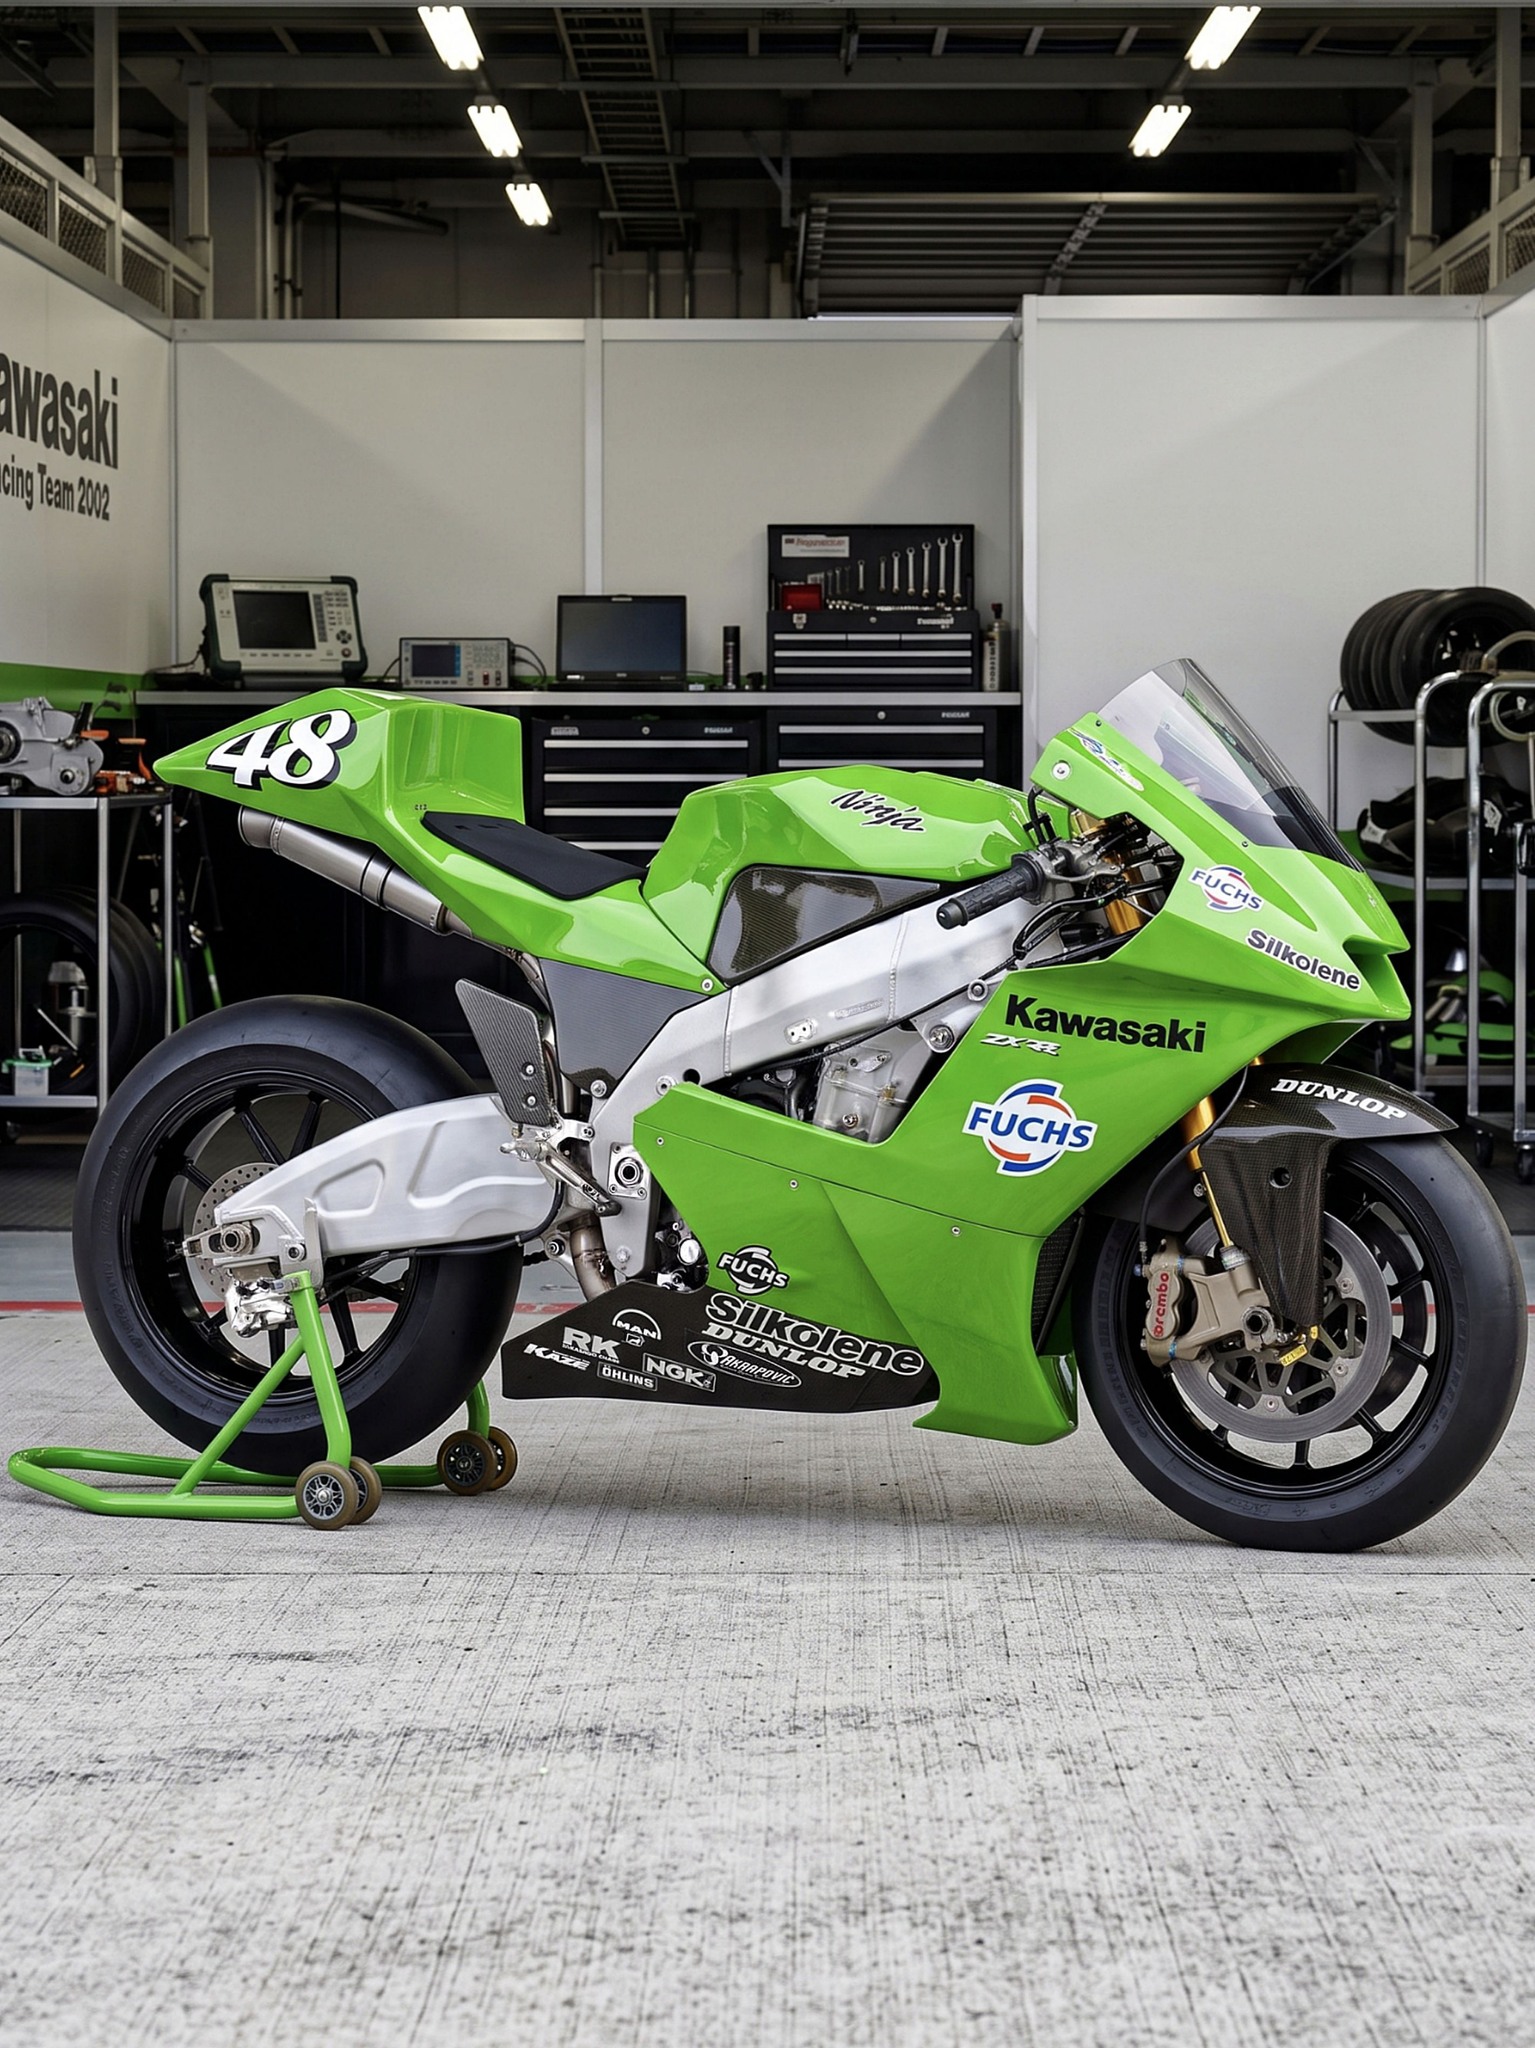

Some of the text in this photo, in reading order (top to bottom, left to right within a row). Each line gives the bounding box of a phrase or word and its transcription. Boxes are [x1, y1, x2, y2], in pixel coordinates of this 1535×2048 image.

[0, 454, 110, 521] cing Team 2002
[205, 708, 358, 791] 48
[830, 790, 925, 831] Ninja
[1191, 870, 1263, 910] FUCHS
[1247, 929, 1361, 990] Silkolene
[1005, 994, 1207, 1053] Kawasaki
[1271, 1078, 1407, 1120] DUNLOP
[968, 1106, 1093, 1149] FUCHS
[718, 1253, 788, 1288] FUCHS
[562, 1326, 621, 1360] RK
[617, 1320, 656, 1339] MAN
[701, 1322, 866, 1378] DUNLOP
[705, 1292, 924, 1376] Silkolene
[602, 1364, 655, 1389] ÖHLINS
[646, 1356, 704, 1387] NGK
